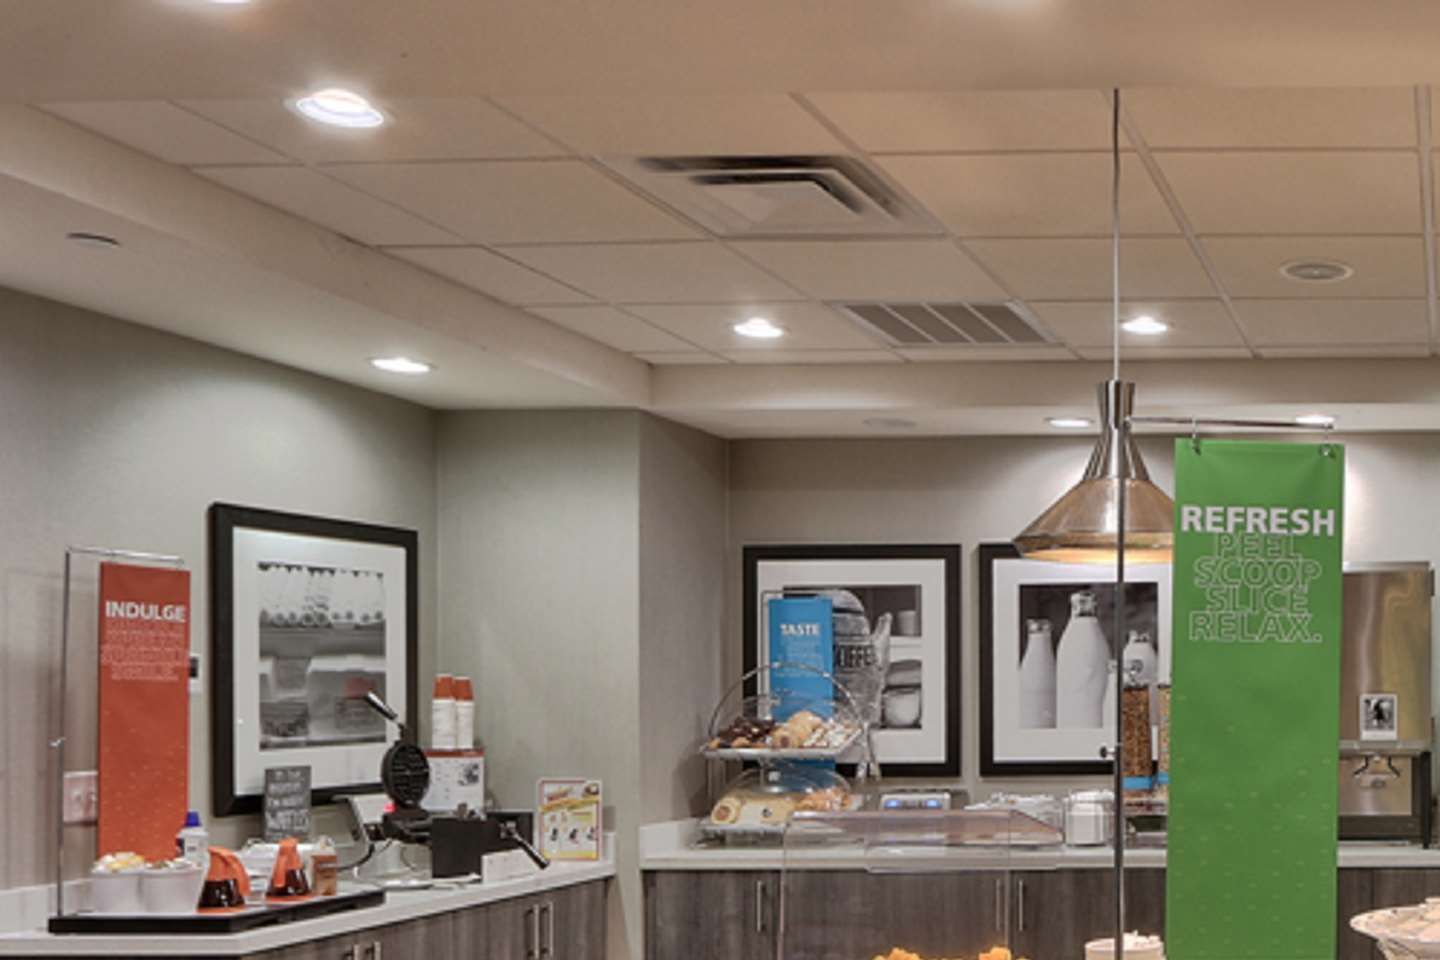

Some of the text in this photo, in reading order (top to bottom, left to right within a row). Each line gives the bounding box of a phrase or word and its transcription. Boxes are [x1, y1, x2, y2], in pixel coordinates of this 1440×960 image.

[1180, 505, 1335, 537] REFRESH
[1215, 530, 1303, 560] PEEL
[1193, 556, 1323, 593] SCOOP
[105, 600, 187, 623] INDULGE
[1206, 585, 1309, 615] SLICE
[780, 622, 820, 637] TASTE
[1188, 610, 1324, 643] RELAX.
